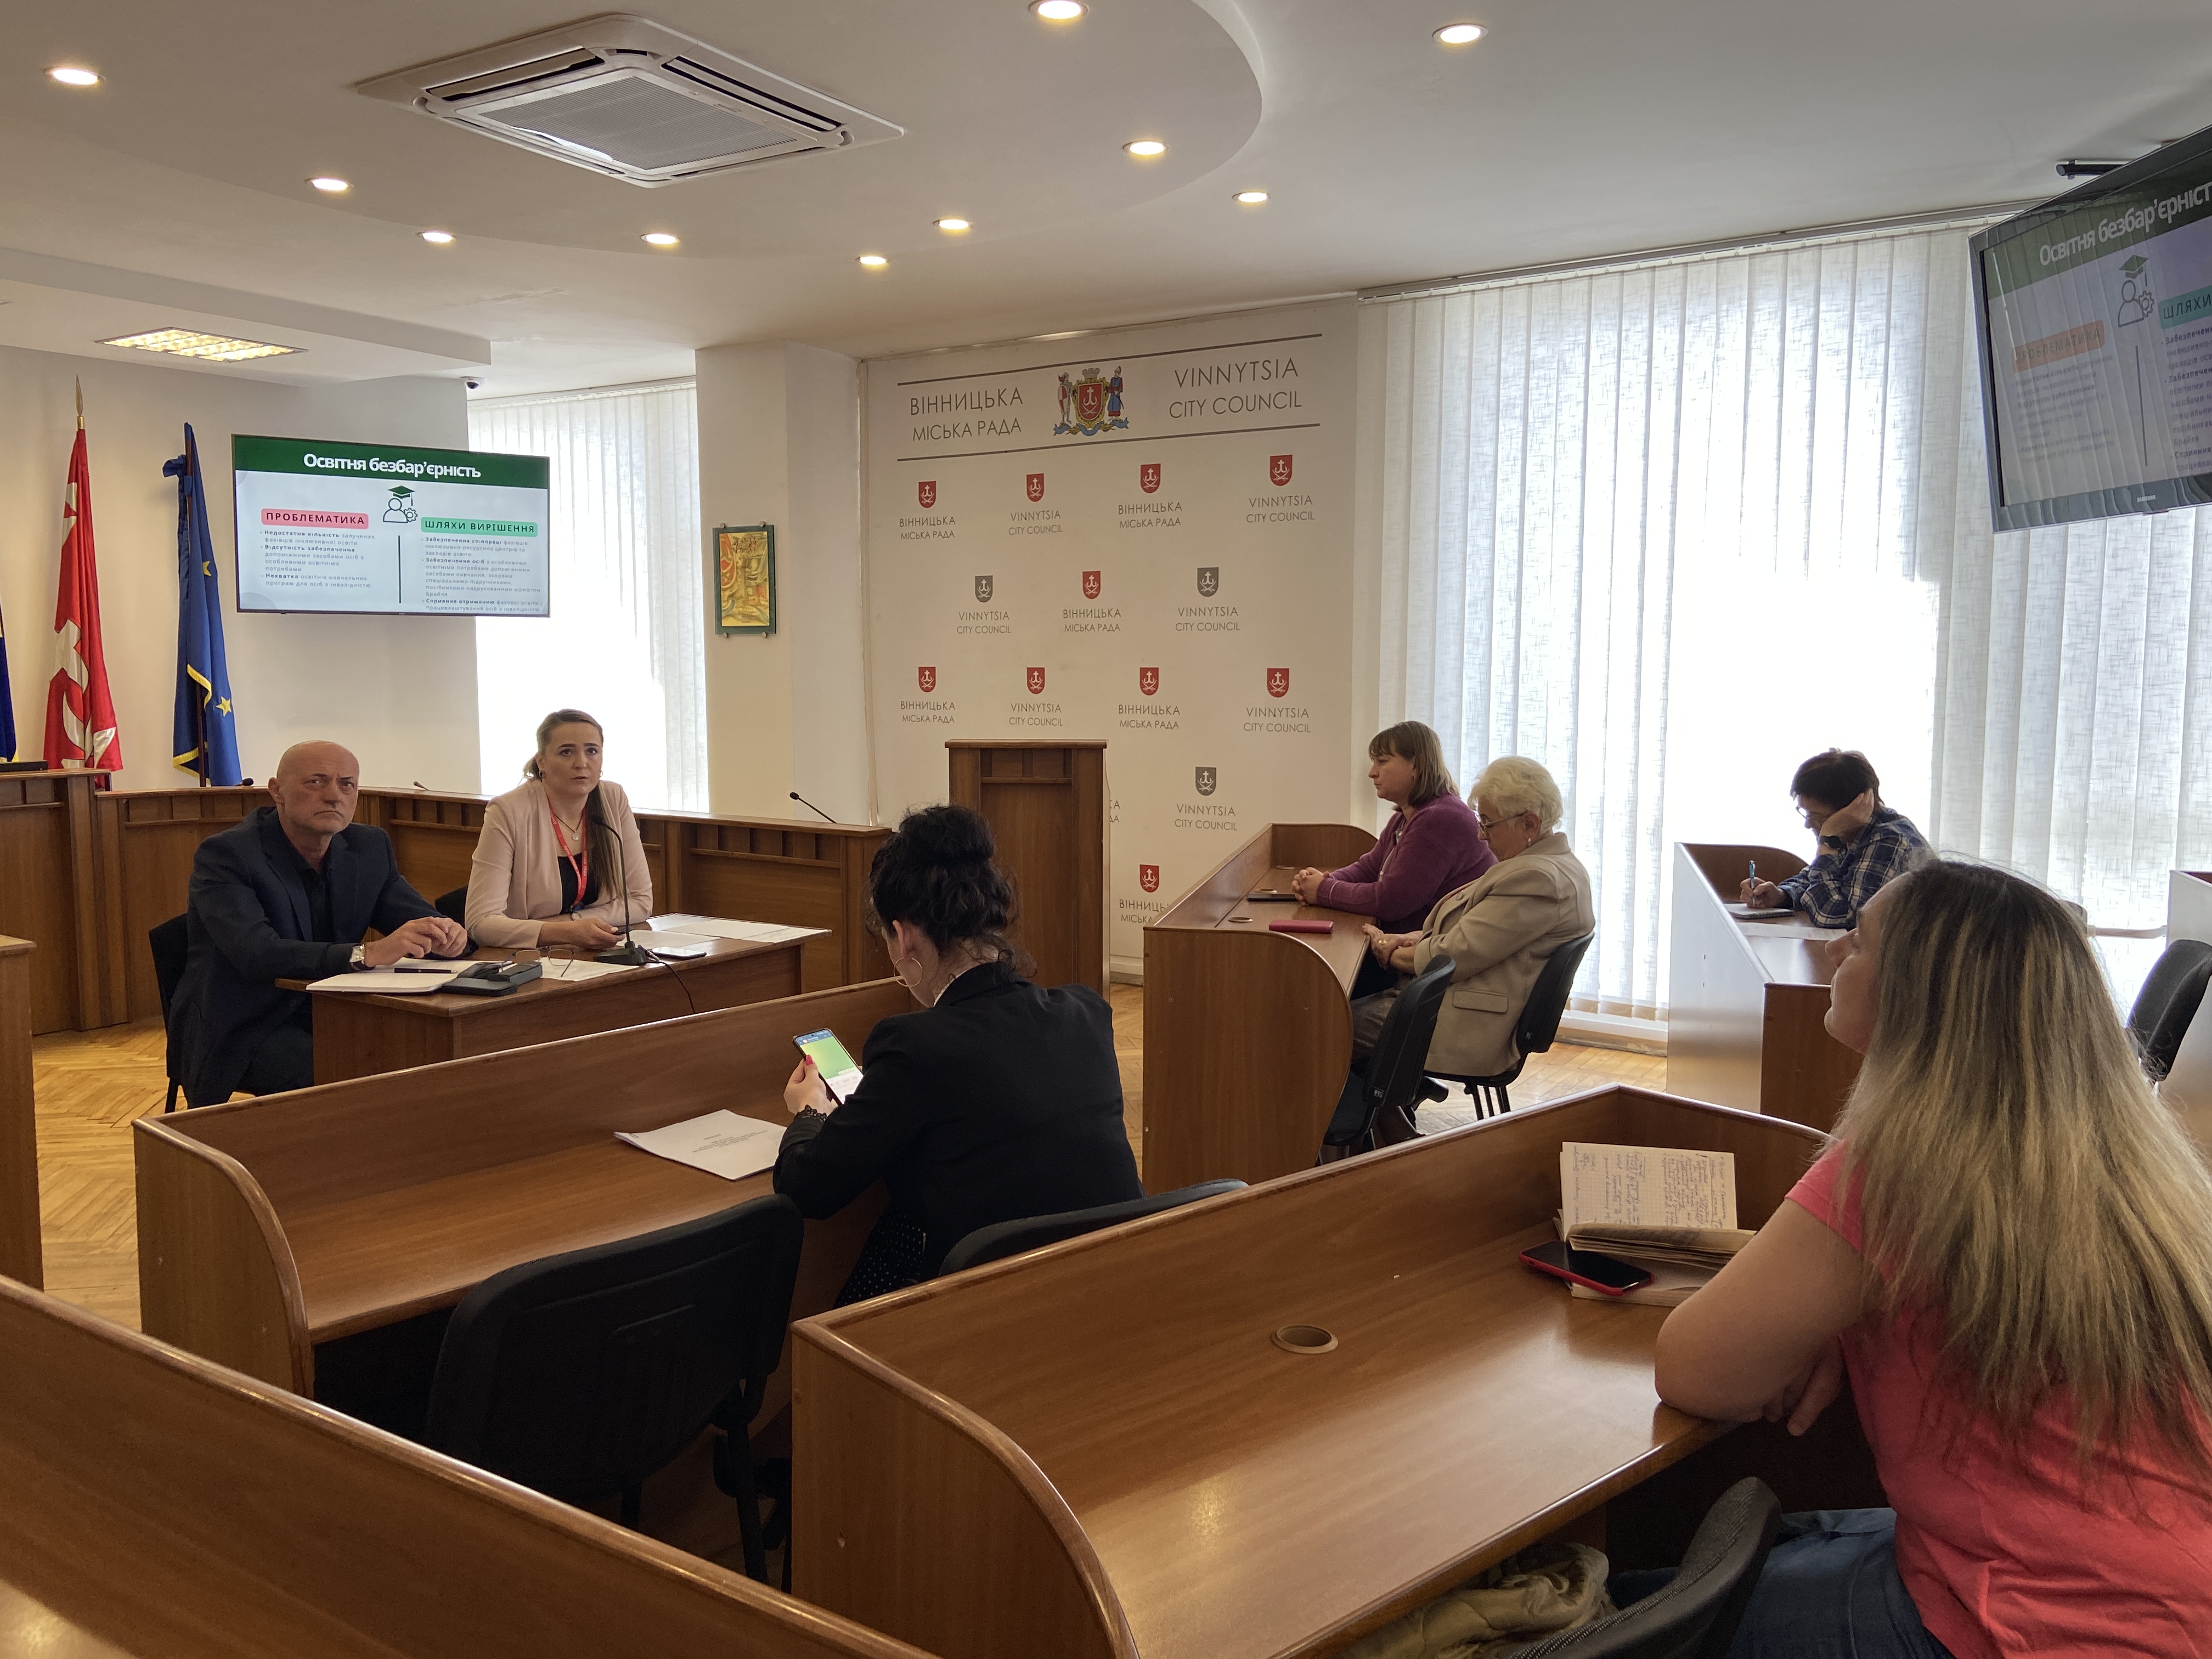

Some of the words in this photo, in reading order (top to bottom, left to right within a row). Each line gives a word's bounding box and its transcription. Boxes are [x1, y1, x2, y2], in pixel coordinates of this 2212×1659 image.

[2039, 229, 2096, 266] Освітня
[2163, 294, 2211, 319] ШЛЯХИ
[1175, 358, 1298, 388] VINNYTSIA
[911, 387, 1023, 415] ВІННИЦЬКА
[1170, 399, 1206, 418] CITY
[1213, 391, 1302, 414] COUNCIL
[913, 422, 972, 441] МІСЬКА
[978, 417, 1022, 437] РАДА
[303, 453, 366, 471] Освітня
[1249, 495, 1312, 507] VINNYTSIA
[1119, 502, 1182, 514] ВІННИЦЬКА
[266, 512, 365, 524] ПРОБЛЕМАТИКА
[1011, 510, 1060, 521] VINNYTSIA
[1246, 514, 1266, 523] CITY
[1269, 511, 1314, 522] COUNCIL
[425, 521, 465, 530] ШЛЯХИ
[470, 523, 534, 533] ВИРІШЕННЯ
[900, 516, 956, 527] ВІННИЦЬКА
[1120, 519, 1153, 528] МІСЬКА
[1156, 518, 1181, 527] РАДА
[933, 531, 955, 539] РАДА
[1009, 527, 1025, 535] CITY
[1028, 524, 1063, 534] COUNCIL
[959, 611, 1009, 620] VINNYTSIA
[1063, 608, 1121, 619] ВІННИЦЬКА
[1178, 607, 1238, 617] VINNYTSIA
[975, 625, 1011, 634] COUNCIL
[1098, 624, 1120, 632] РАДА
[1176, 623, 1194, 631] CITY
[1197, 622, 1240, 631] COUNCIL
[901, 701, 955, 711] ВІННИЦЬКА
[1011, 703, 1062, 713] VINNYTSIA
[1119, 704, 1180, 715] ВІННИЦЬКА
[1246, 708, 1309, 718] VINNYTSIA
[1028, 718, 1063, 726] COUNCIL
[1120, 720, 1152, 728] МІСЬКА
[1155, 720, 1179, 730] РАДА
[1244, 723, 1263, 731] CITY
[1266, 723, 1311, 732] COUNCIL
[1177, 804, 1235, 816] VINNYTSIA
[1175, 819, 1193, 827] CITY
[1195, 820, 1237, 831] COUNCIL
